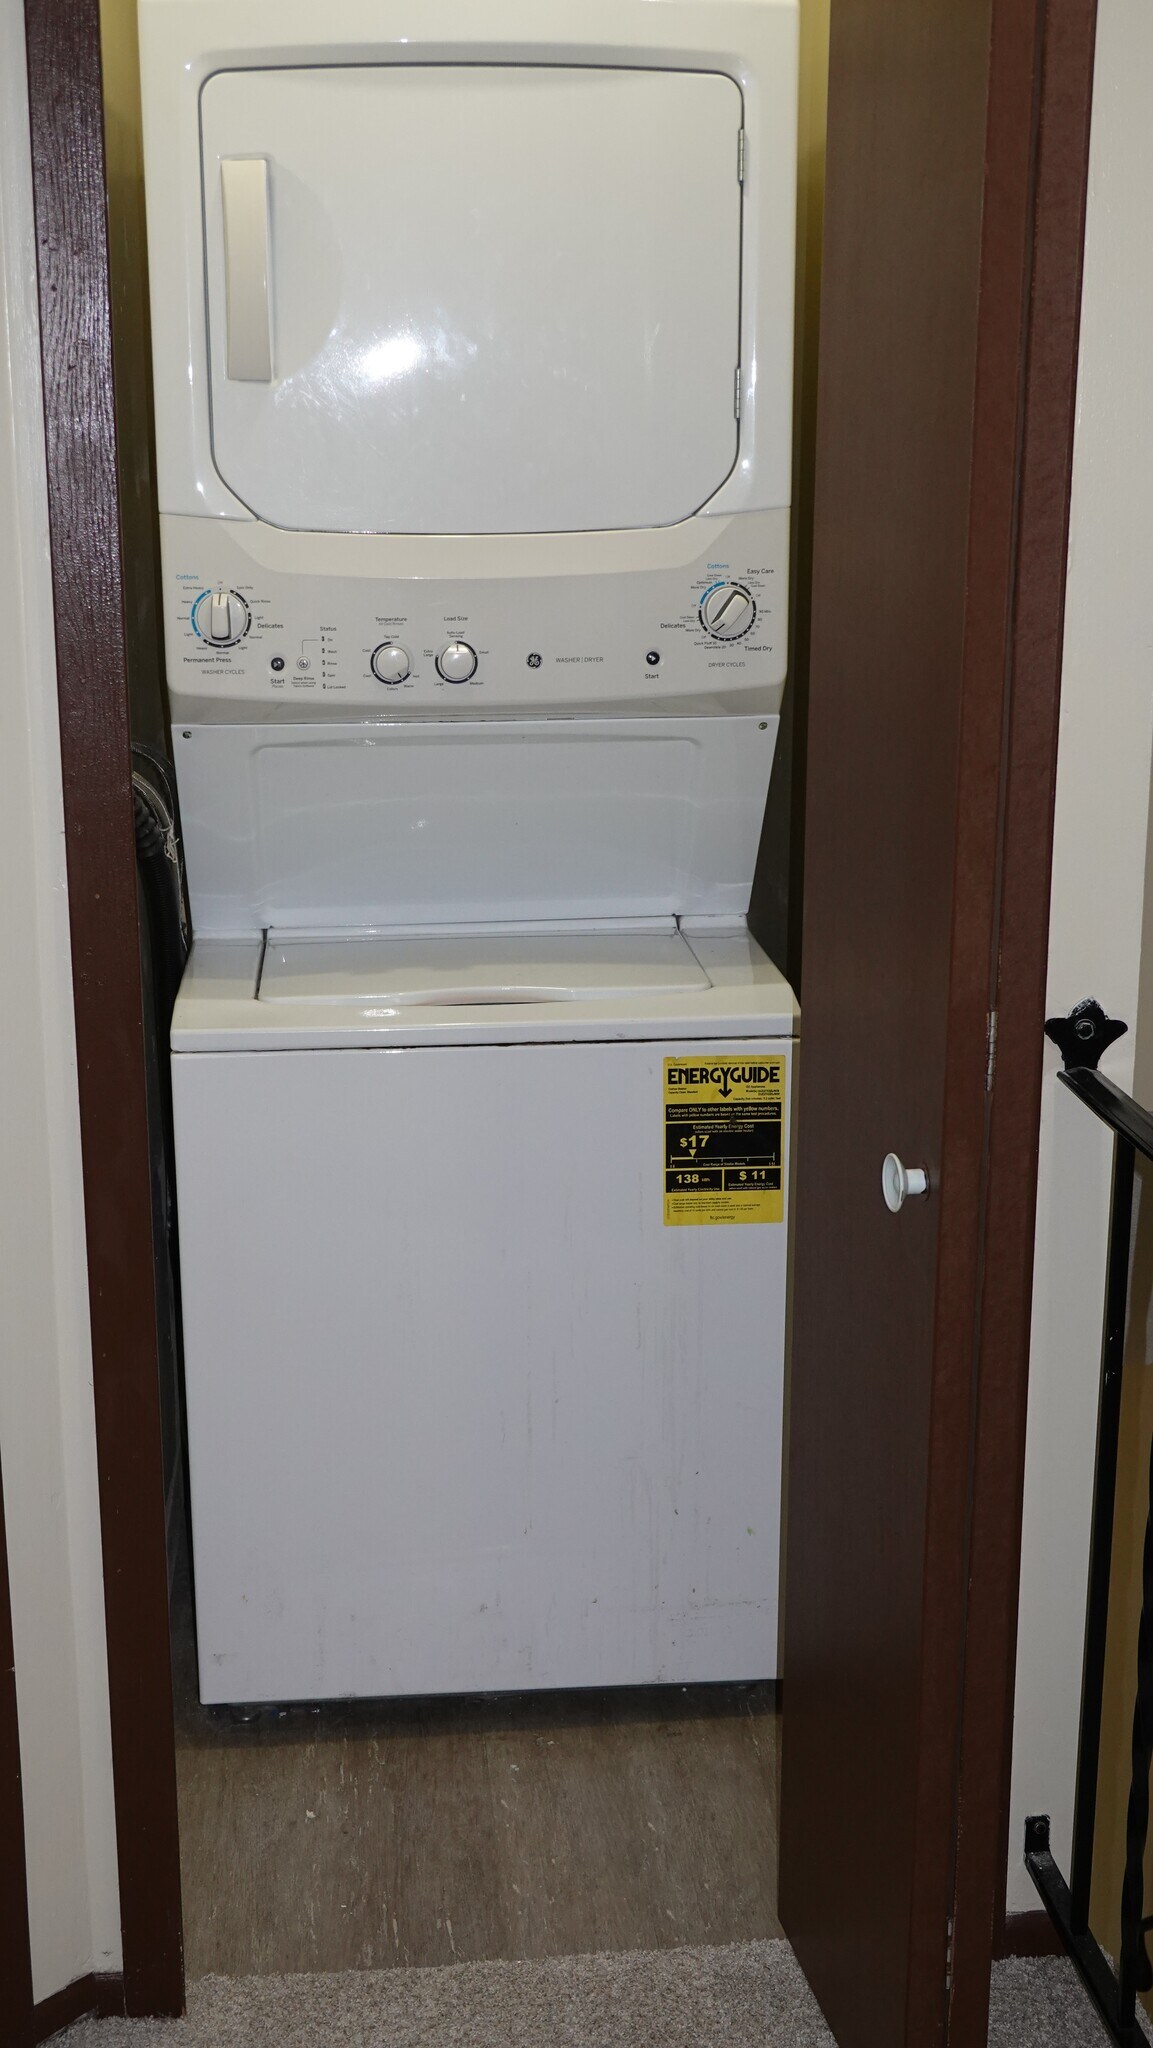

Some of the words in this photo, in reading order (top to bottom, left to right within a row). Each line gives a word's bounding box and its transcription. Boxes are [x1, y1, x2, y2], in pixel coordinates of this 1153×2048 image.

[668, 1066, 780, 1085] ENERGYGUIDE
[680, 1135, 710, 1148] $17
[676, 1174, 699, 1184] 138
[739, 1171, 747, 1181] $
[752, 1170, 766, 1180] 11
